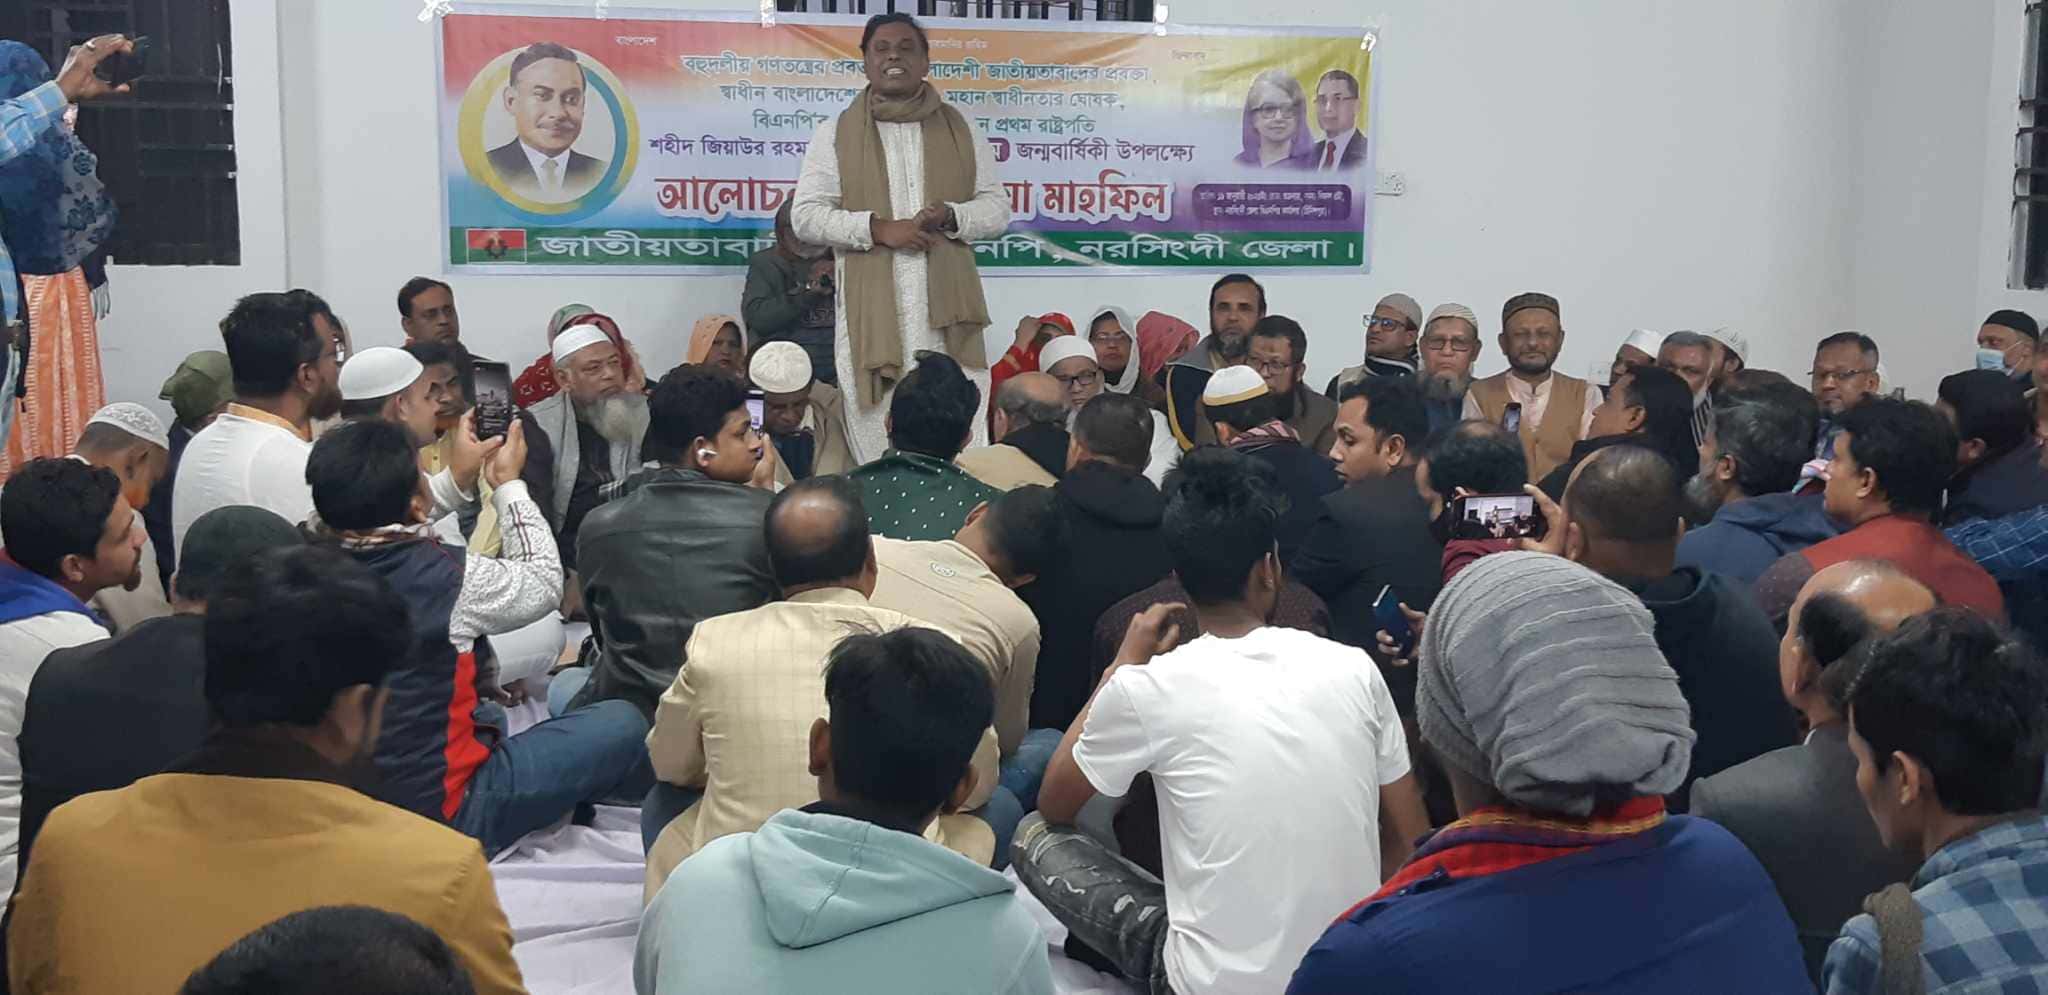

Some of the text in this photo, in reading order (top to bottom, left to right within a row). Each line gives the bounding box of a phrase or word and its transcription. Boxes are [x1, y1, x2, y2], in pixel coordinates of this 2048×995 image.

[683, 51, 751, 73] বহুদলীয়
[757, 57, 825, 74] গণতন্ত্রের
[986, 57, 1098, 81] জাতীয়তাবাদের
[720, 80, 765, 101] স্বাধীন
[945, 90, 987, 105] মহান
[991, 86, 1063, 107] স্বাধীনতার
[995, 117, 1032, 133] প্রথম
[1037, 114, 1096, 136] রাষ্ট্রপতি
[648, 133, 695, 155] শহীদ
[701, 135, 765, 156] জিয়াউর
[1016, 137, 1110, 162] জন্মবার্ষিকী
[1042, 169, 1167, 216] মাহফিল
[1077, 233, 1230, 260] নরসিংদী
[1241, 239, 1333, 260] জেলা
